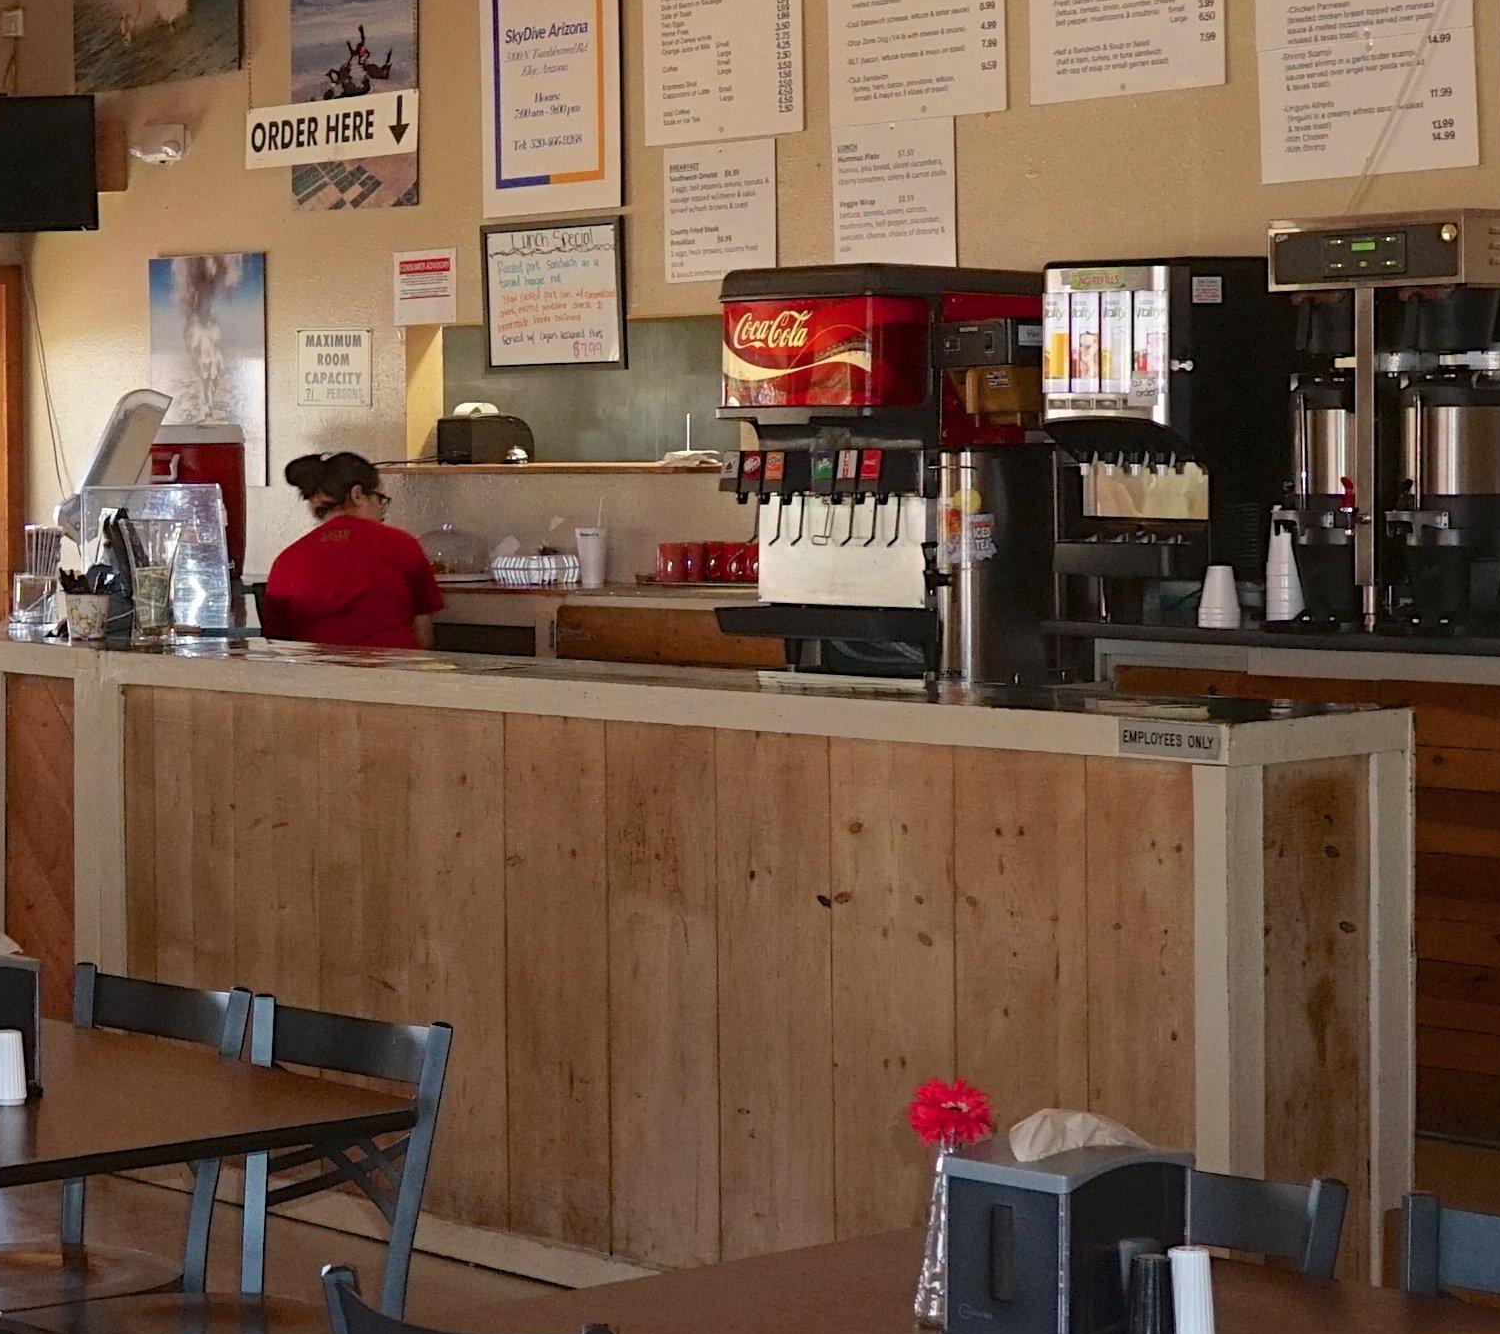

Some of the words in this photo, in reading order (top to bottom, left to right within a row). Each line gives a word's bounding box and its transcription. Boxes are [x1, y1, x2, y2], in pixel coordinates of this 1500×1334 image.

[505, 26, 546, 45] SkyDive
[548, 22, 588, 38] Arizona
[251, 117, 319, 152] ORDER
[325, 109, 375, 145] HERE
[510, 231, 549, 249] Lunch
[553, 228, 594, 247] Special
[733, 309, 813, 350] Coca-Cola
[305, 334, 363, 347] MAXIMUM
[317, 353, 350, 366] ROOM
[305, 372, 362, 385] CAPACITY
[326, 388, 363, 400] PERSONS
[973, 527, 991, 538] ICED
[1123, 730, 1182, 747] EMPLOYEES
[1187, 735, 1214, 749] ONLY
